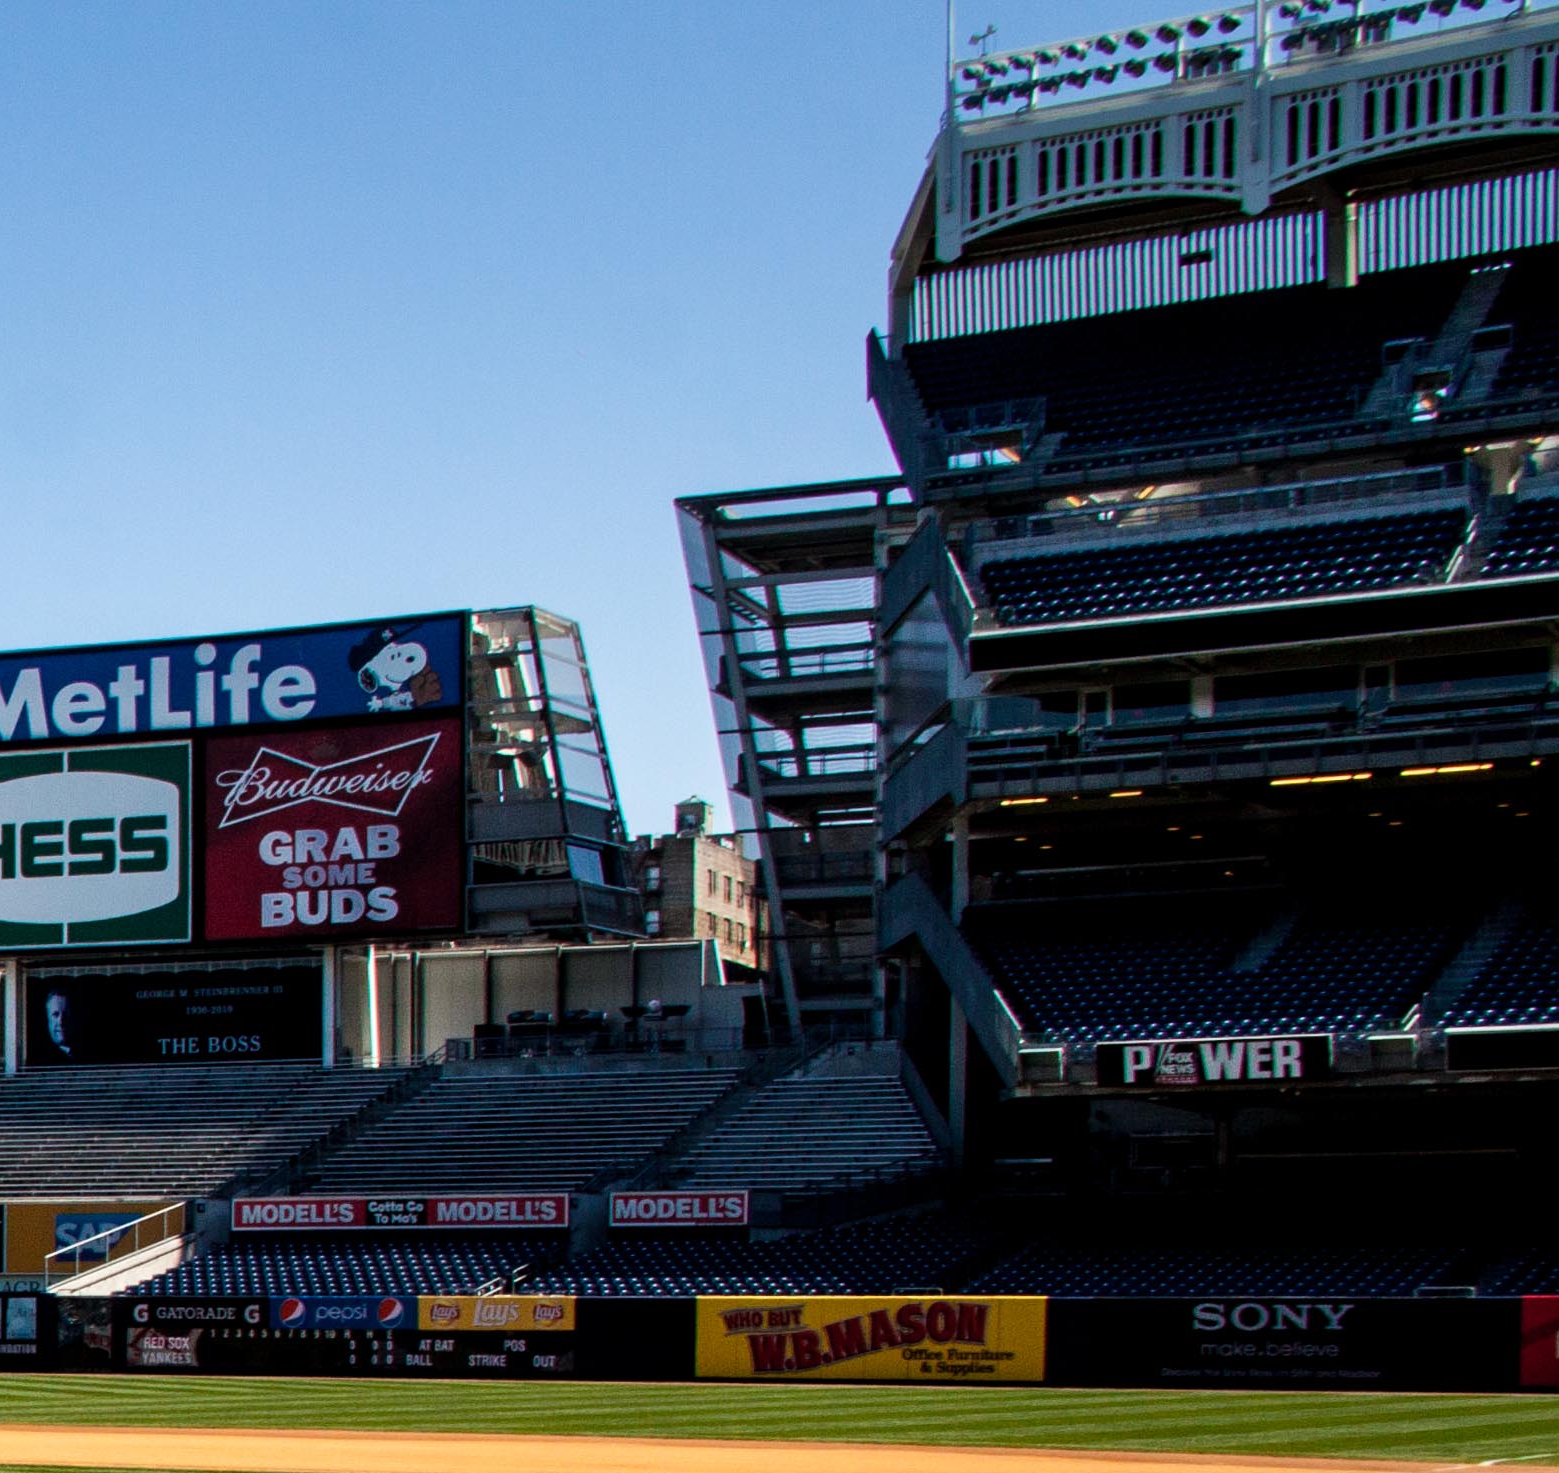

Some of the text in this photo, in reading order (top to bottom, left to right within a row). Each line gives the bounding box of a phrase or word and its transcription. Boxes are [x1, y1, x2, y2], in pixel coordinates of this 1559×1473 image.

[215, 763, 434, 808] Budweiser
[259, 824, 401, 866] GRAB
[282, 862, 376, 889] SOME
[261, 886, 399, 928] BUDS
[157, 1034, 262, 1055] THE BOSS
[241, 1203, 355, 1224] MODELL'S
[374, 1213, 389, 1224] To
[437, 1201, 557, 1222] MODELL'S
[615, 1196, 744, 1222] MODELL'S
[56, 1222, 121, 1254] SAP
[155, 1307, 238, 1321] GATORADE
[315, 1303, 368, 1324] pepsi
[723, 1308, 804, 1330] WHO BUT
[1191, 1302, 1355, 1332] SONY
[143, 1336, 166, 1349] RED
[167, 1337, 190, 1350] SOX
[419, 1338, 527, 1352] AT BAT POS
[142, 1352, 192, 1365] YANKEES
[405, 1353, 557, 1368] BALL STRIKE OUT
[902, 1349, 1015, 1362] Office Furniture
[919, 1362, 996, 1376] & Supplies
